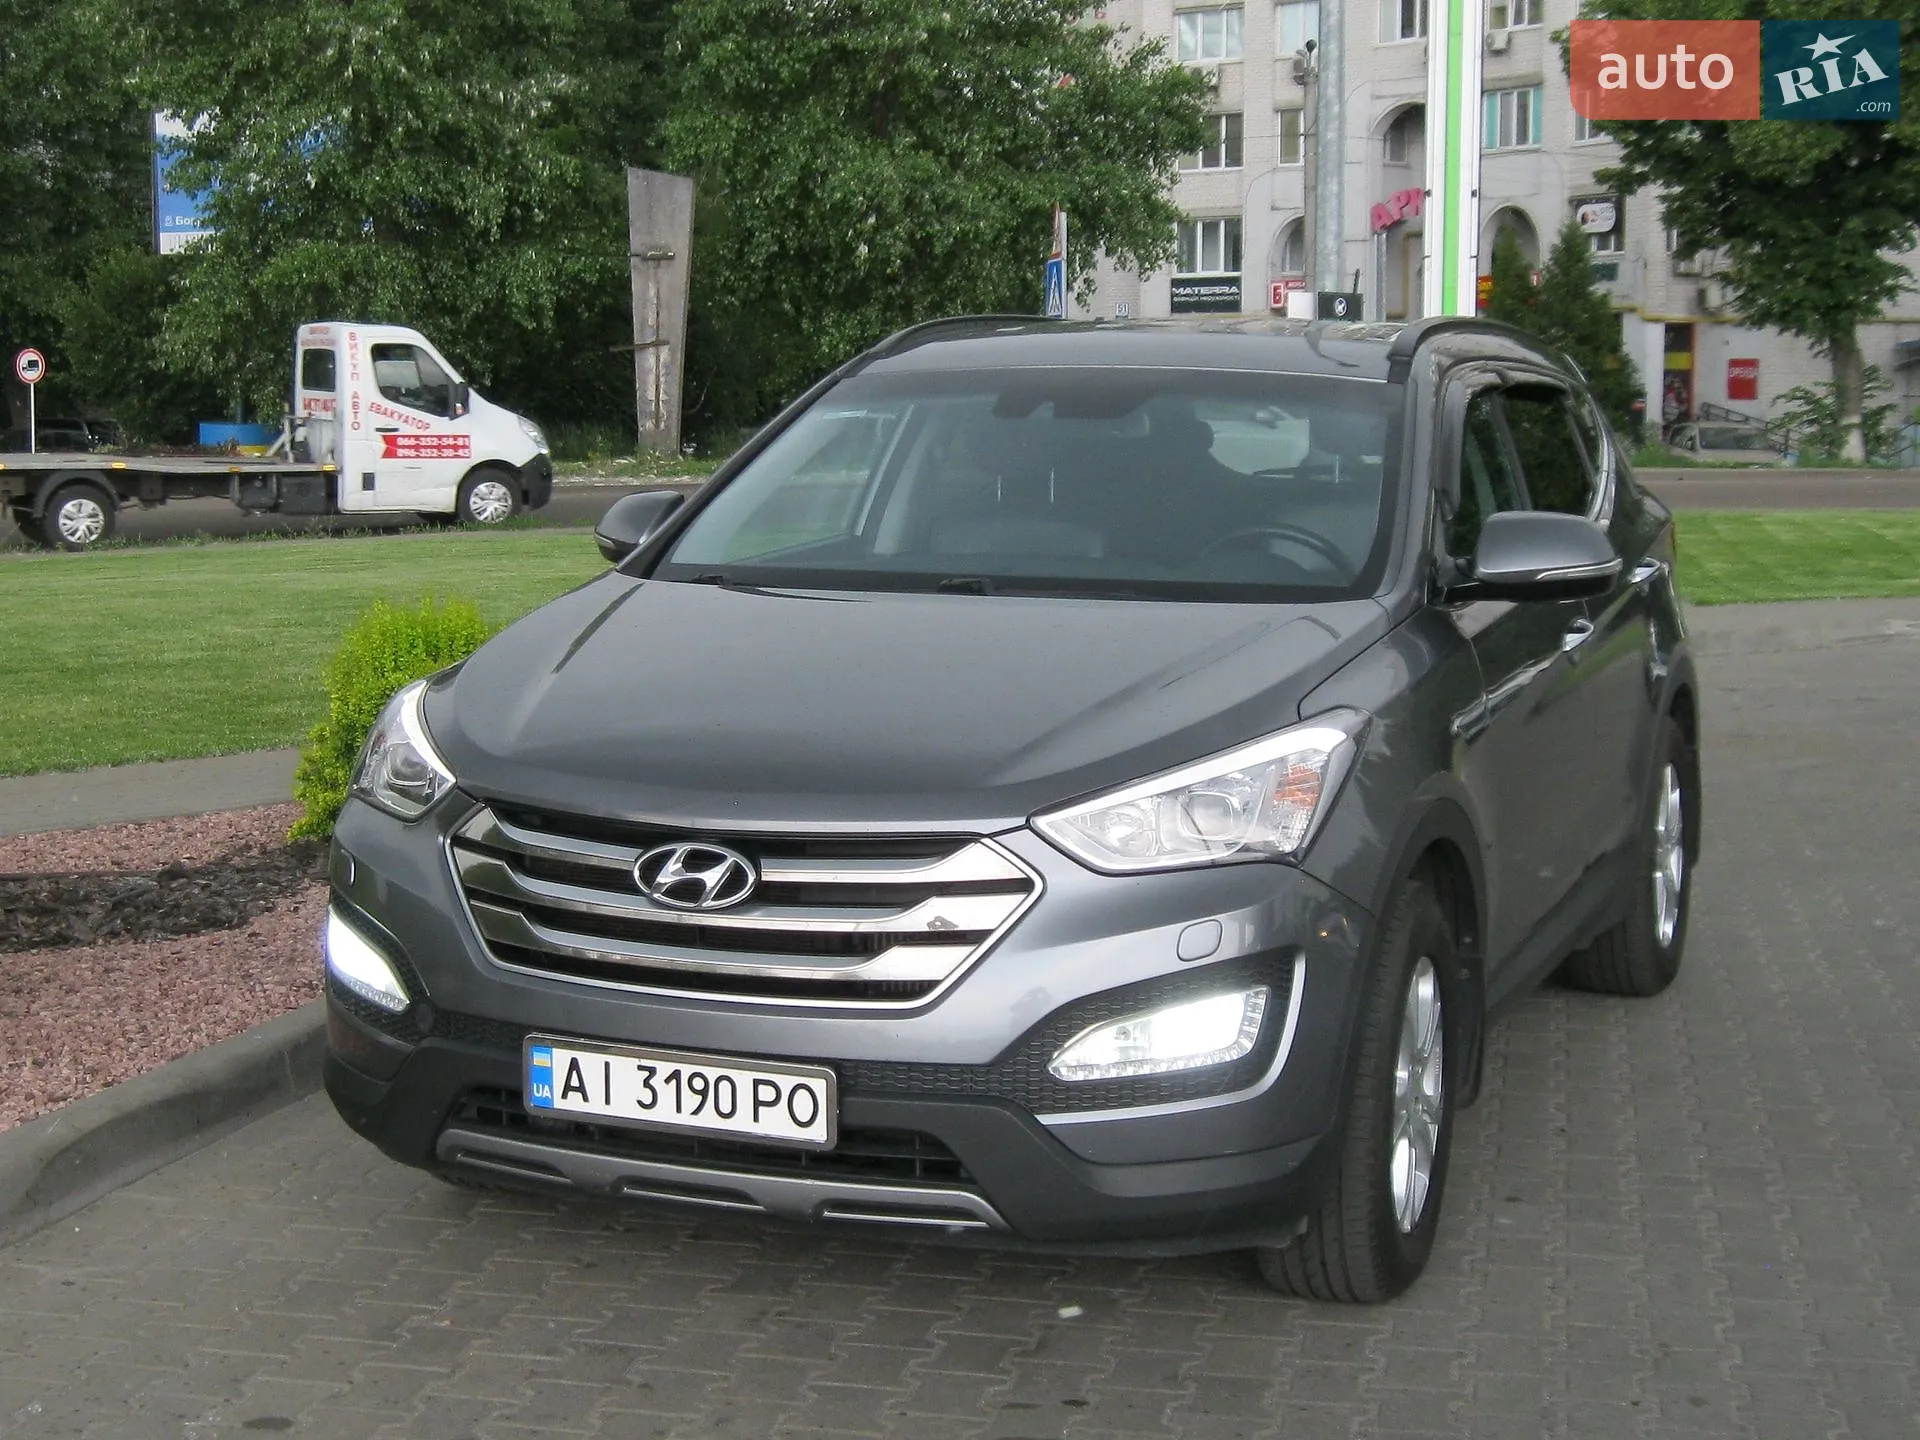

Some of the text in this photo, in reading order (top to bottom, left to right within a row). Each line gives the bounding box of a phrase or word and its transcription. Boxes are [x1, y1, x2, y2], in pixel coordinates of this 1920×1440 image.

[1172, 286, 1240, 295] MATERRA
[348, 332, 361, 431] ВИКУП АВТО
[369, 402, 431, 431] ЕВАКУАТОР
[534, 1084, 552, 1099] UA
[561, 1056, 820, 1128] AI 3190 PO
